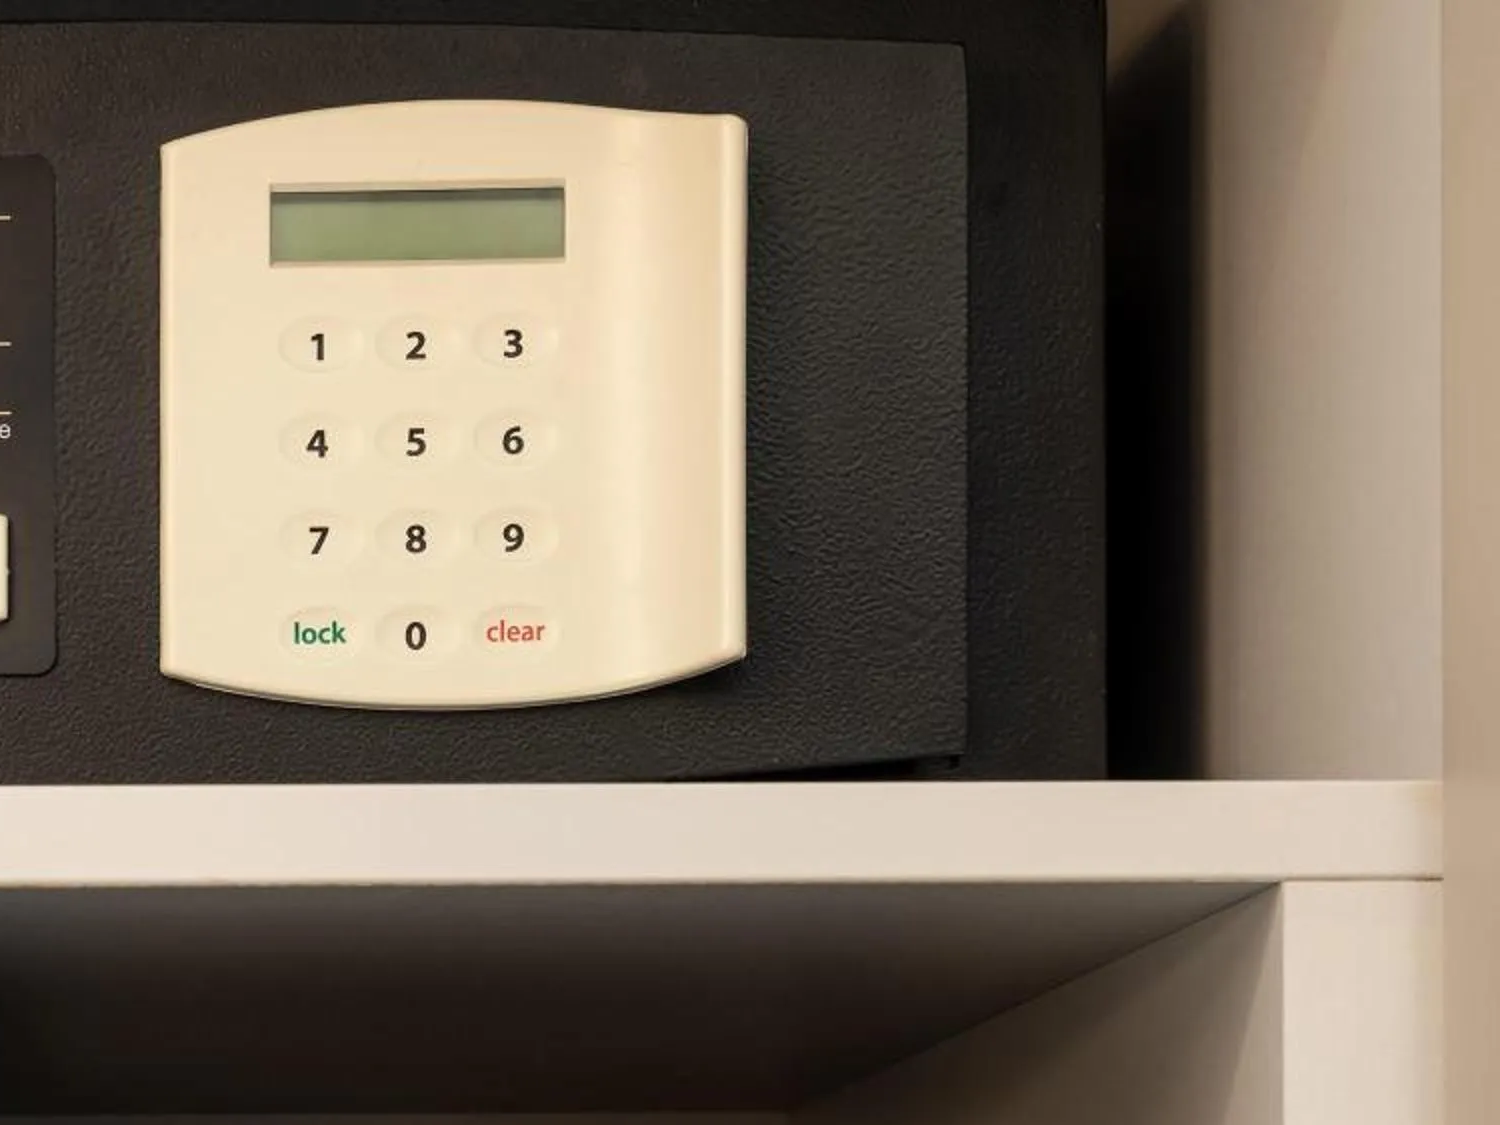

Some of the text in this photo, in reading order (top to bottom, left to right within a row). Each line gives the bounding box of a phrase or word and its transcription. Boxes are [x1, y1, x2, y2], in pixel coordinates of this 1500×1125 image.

[309, 333, 326, 361] 1
[405, 331, 427, 361] 2
[502, 329, 524, 359] 3
[306, 430, 329, 457] 4
[407, 428, 427, 456] 5
[502, 426, 525, 455] 6
[308, 526, 330, 555] 7
[405, 525, 428, 554] 8
[502, 523, 525, 553] 9
[293, 621, 347, 645] lock
[405, 621, 427, 651] 0
[486, 618, 547, 643] clear
